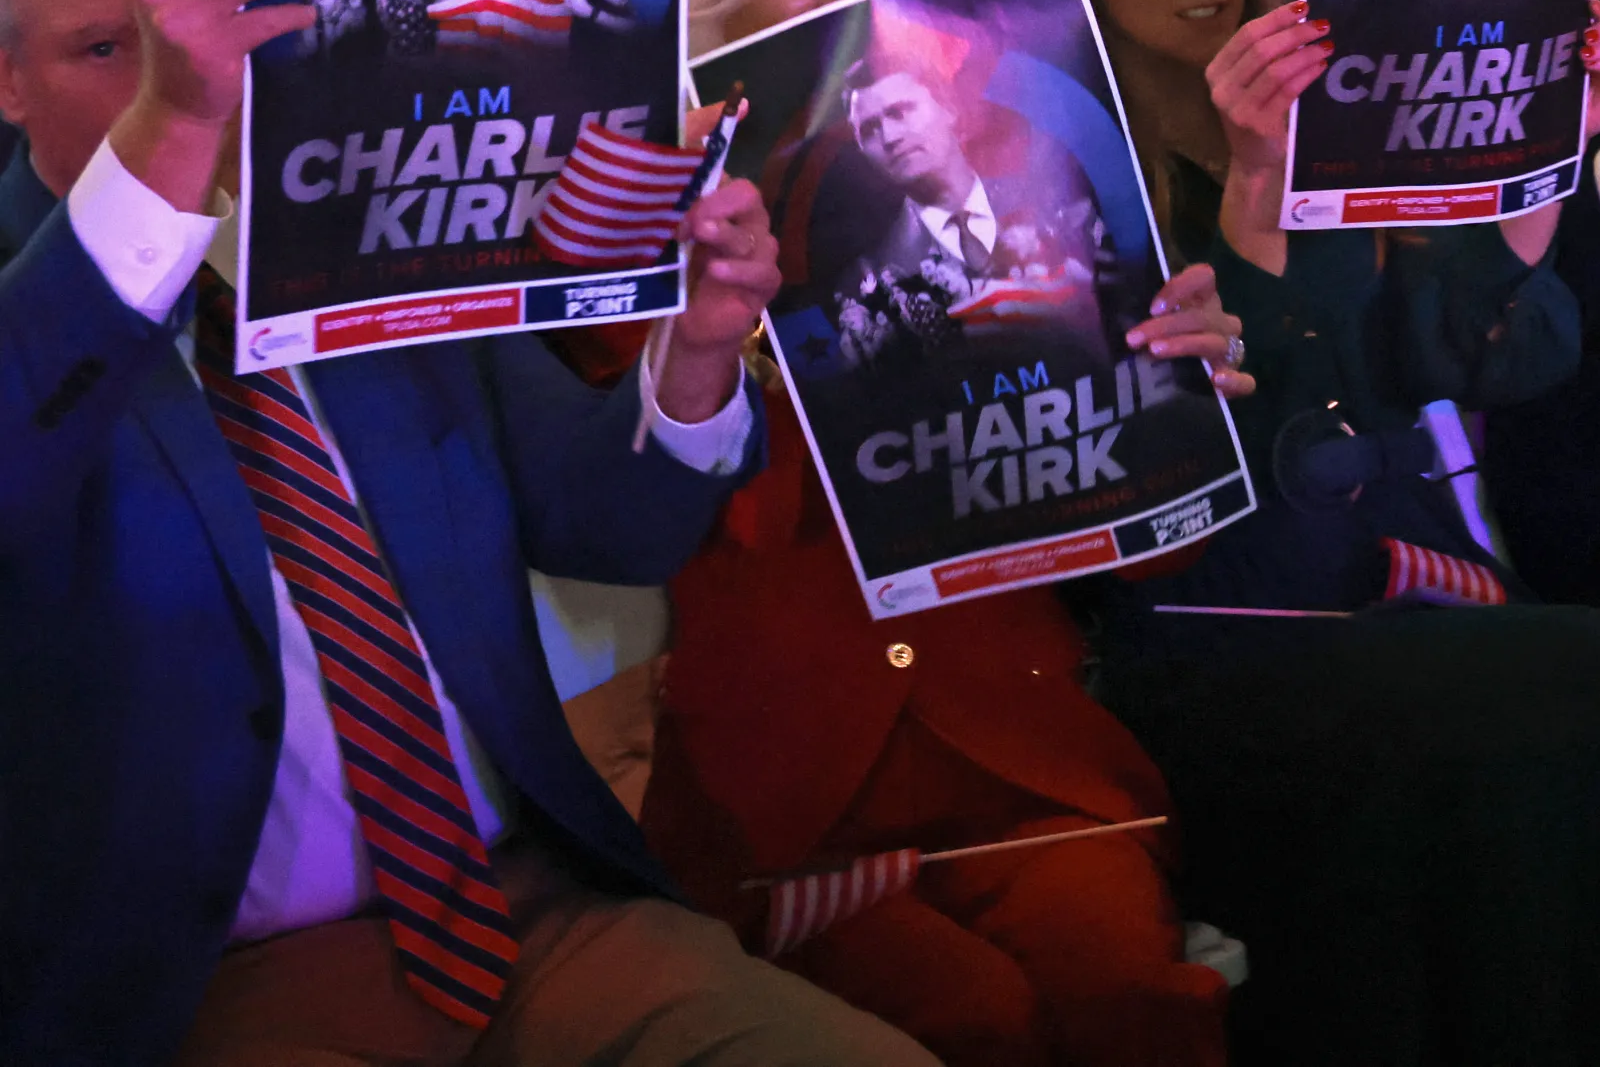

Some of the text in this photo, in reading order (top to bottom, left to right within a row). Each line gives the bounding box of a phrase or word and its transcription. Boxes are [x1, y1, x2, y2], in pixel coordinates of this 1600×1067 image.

[1434, 20, 1505, 49] I AM
[1325, 30, 1579, 104] CHARLIE
[413, 85, 511, 122] I AM
[1384, 92, 1536, 152] KIRK
[358, 178, 558, 255] KIRK
[438, 249, 544, 275] TURNIN
[564, 295, 638, 319] POINT
[961, 360, 1050, 406] I AM
[856, 356, 1176, 484] CHARLIE
[951, 423, 1129, 522] KIRK
